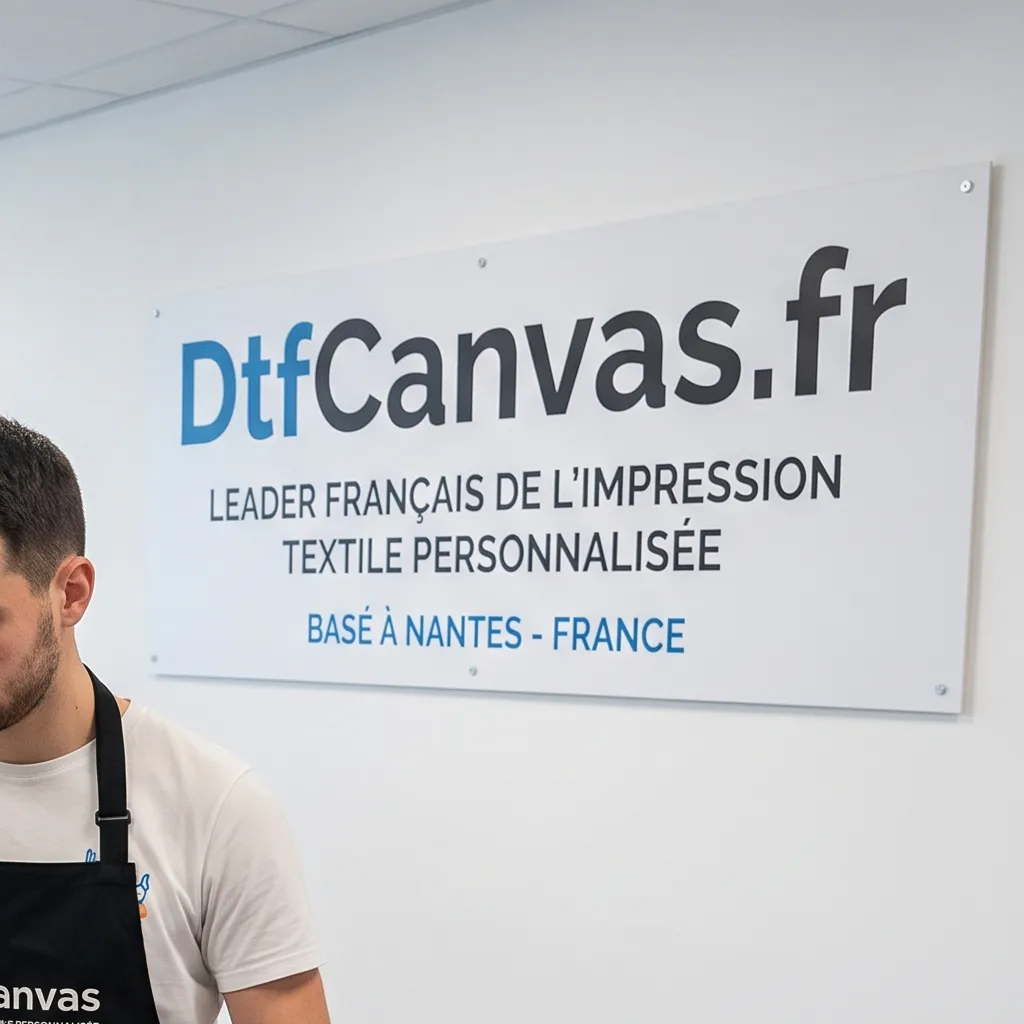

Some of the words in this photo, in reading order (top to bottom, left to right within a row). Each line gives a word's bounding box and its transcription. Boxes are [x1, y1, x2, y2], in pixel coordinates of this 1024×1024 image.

[182, 246, 907, 445] DtfCanvas.fr
[211, 484, 315, 521] LEADER
[327, 474, 483, 524] FRANÇAIS
[497, 471, 540, 510] DE
[554, 455, 841, 508] L'IMPRESSION
[283, 538, 402, 573] TEXTILE
[414, 518, 721, 573] PERSONNALISÉE
[307, 606, 372, 645] BASÉ
[380, 606, 398, 646] À
[407, 616, 521, 648] NANTES
[554, 617, 685, 653] FRANCE
